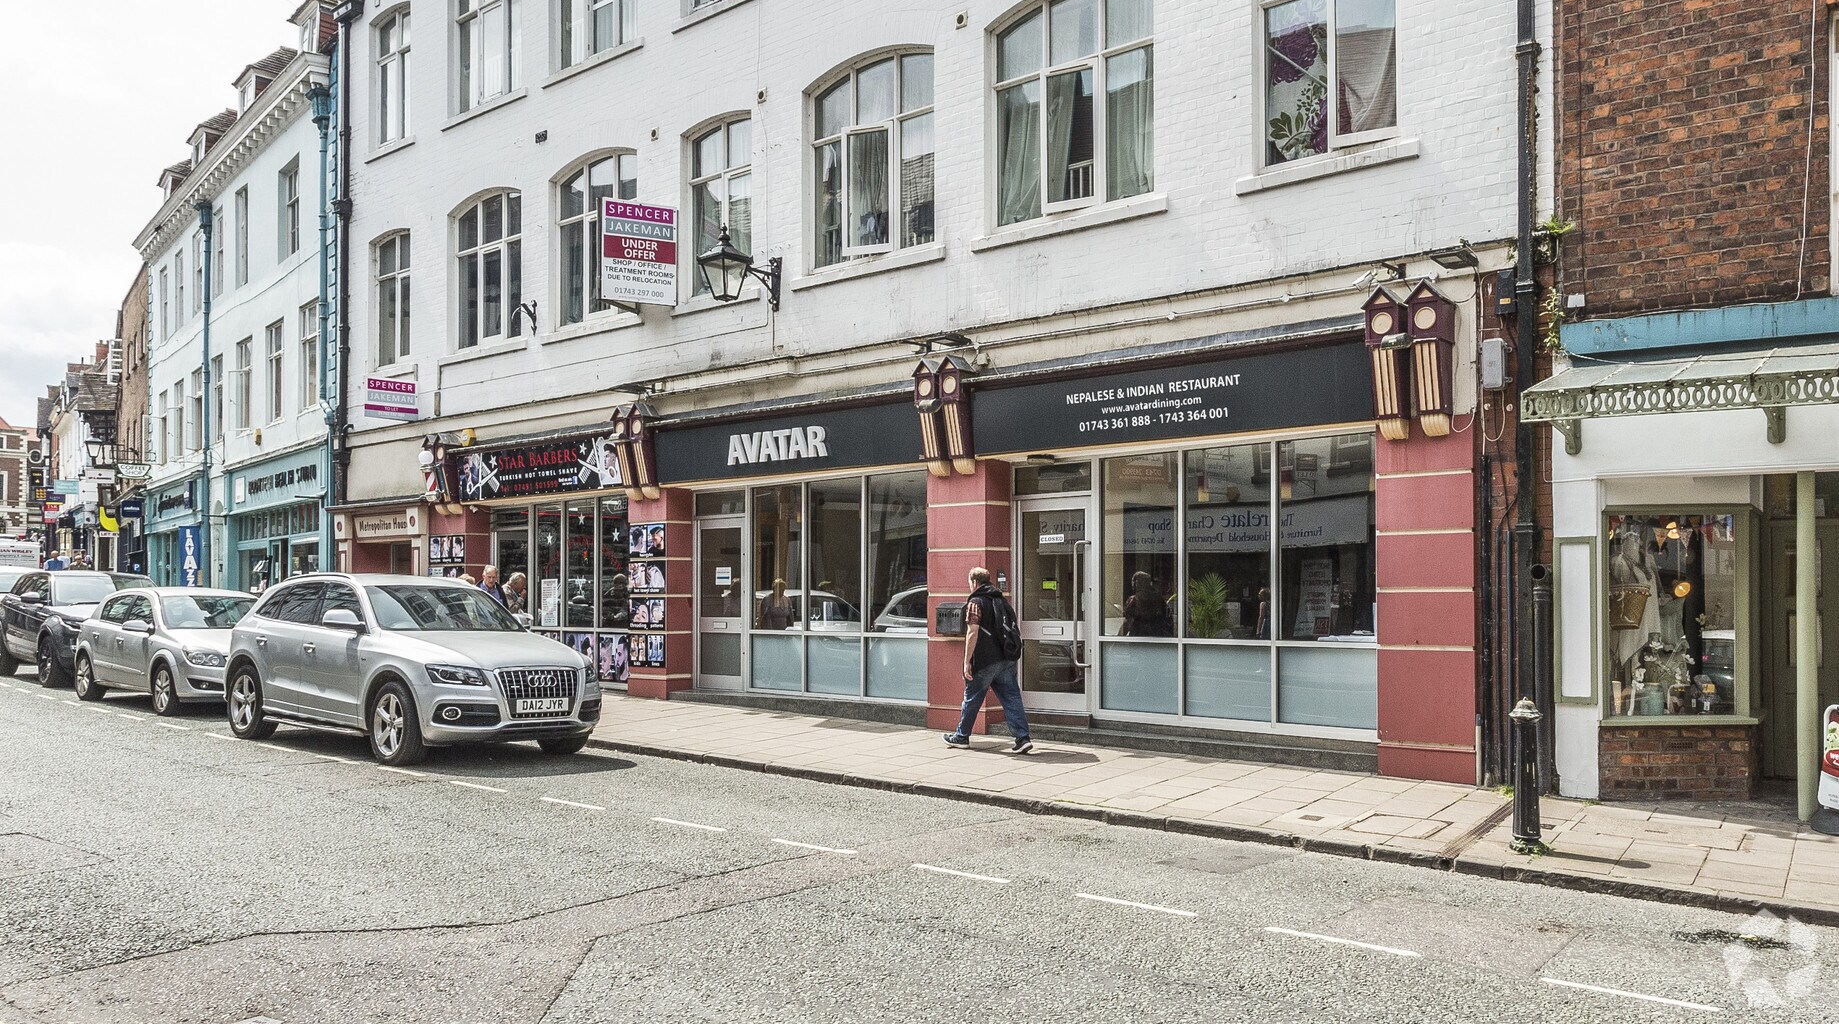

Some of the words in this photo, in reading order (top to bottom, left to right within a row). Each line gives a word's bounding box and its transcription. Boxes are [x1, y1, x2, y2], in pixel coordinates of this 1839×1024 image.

[608, 204, 670, 221] SPENCER
[608, 221, 671, 237] JAKEMAN
[622, 238, 658, 251] UNDER
[624, 249, 656, 260] OFFER
[605, 266, 646, 276] TREATMENT
[637, 262, 662, 270] OFFICE
[632, 276, 672, 286] RELOCATION
[614, 287, 636, 295] 01743
[637, 289, 650, 297] 297
[369, 380, 413, 391] SPENCER
[1066, 389, 1115, 405] NEPALESE
[1116, 388, 1125, 399] &
[1126, 383, 1164, 398] INDIAN
[1168, 374, 1241, 393] RESTAURANT
[369, 392, 414, 403] JAKEMAN
[1101, 395, 1202, 414] www.avatardining.com
[1079, 419, 1109, 432] 01743
[1111, 417, 1129, 429] 361
[1131, 415, 1151, 427] 888
[1158, 411, 1185, 424] 1743
[1187, 409, 1207, 421] 364
[1208, 407, 1229, 419] 001
[727, 425, 828, 466] AVATAR
[499, 455, 525, 471] STAR
[529, 448, 578, 467] BARBERS
[558, 467, 577, 475] SHAVE
[360, 519, 391, 534] Metropolitan
[392, 517, 407, 529] Hous
[183, 529, 198, 586] LAVAZZ
[522, 700, 543, 711] DA12
[546, 699, 564, 710] JYR
